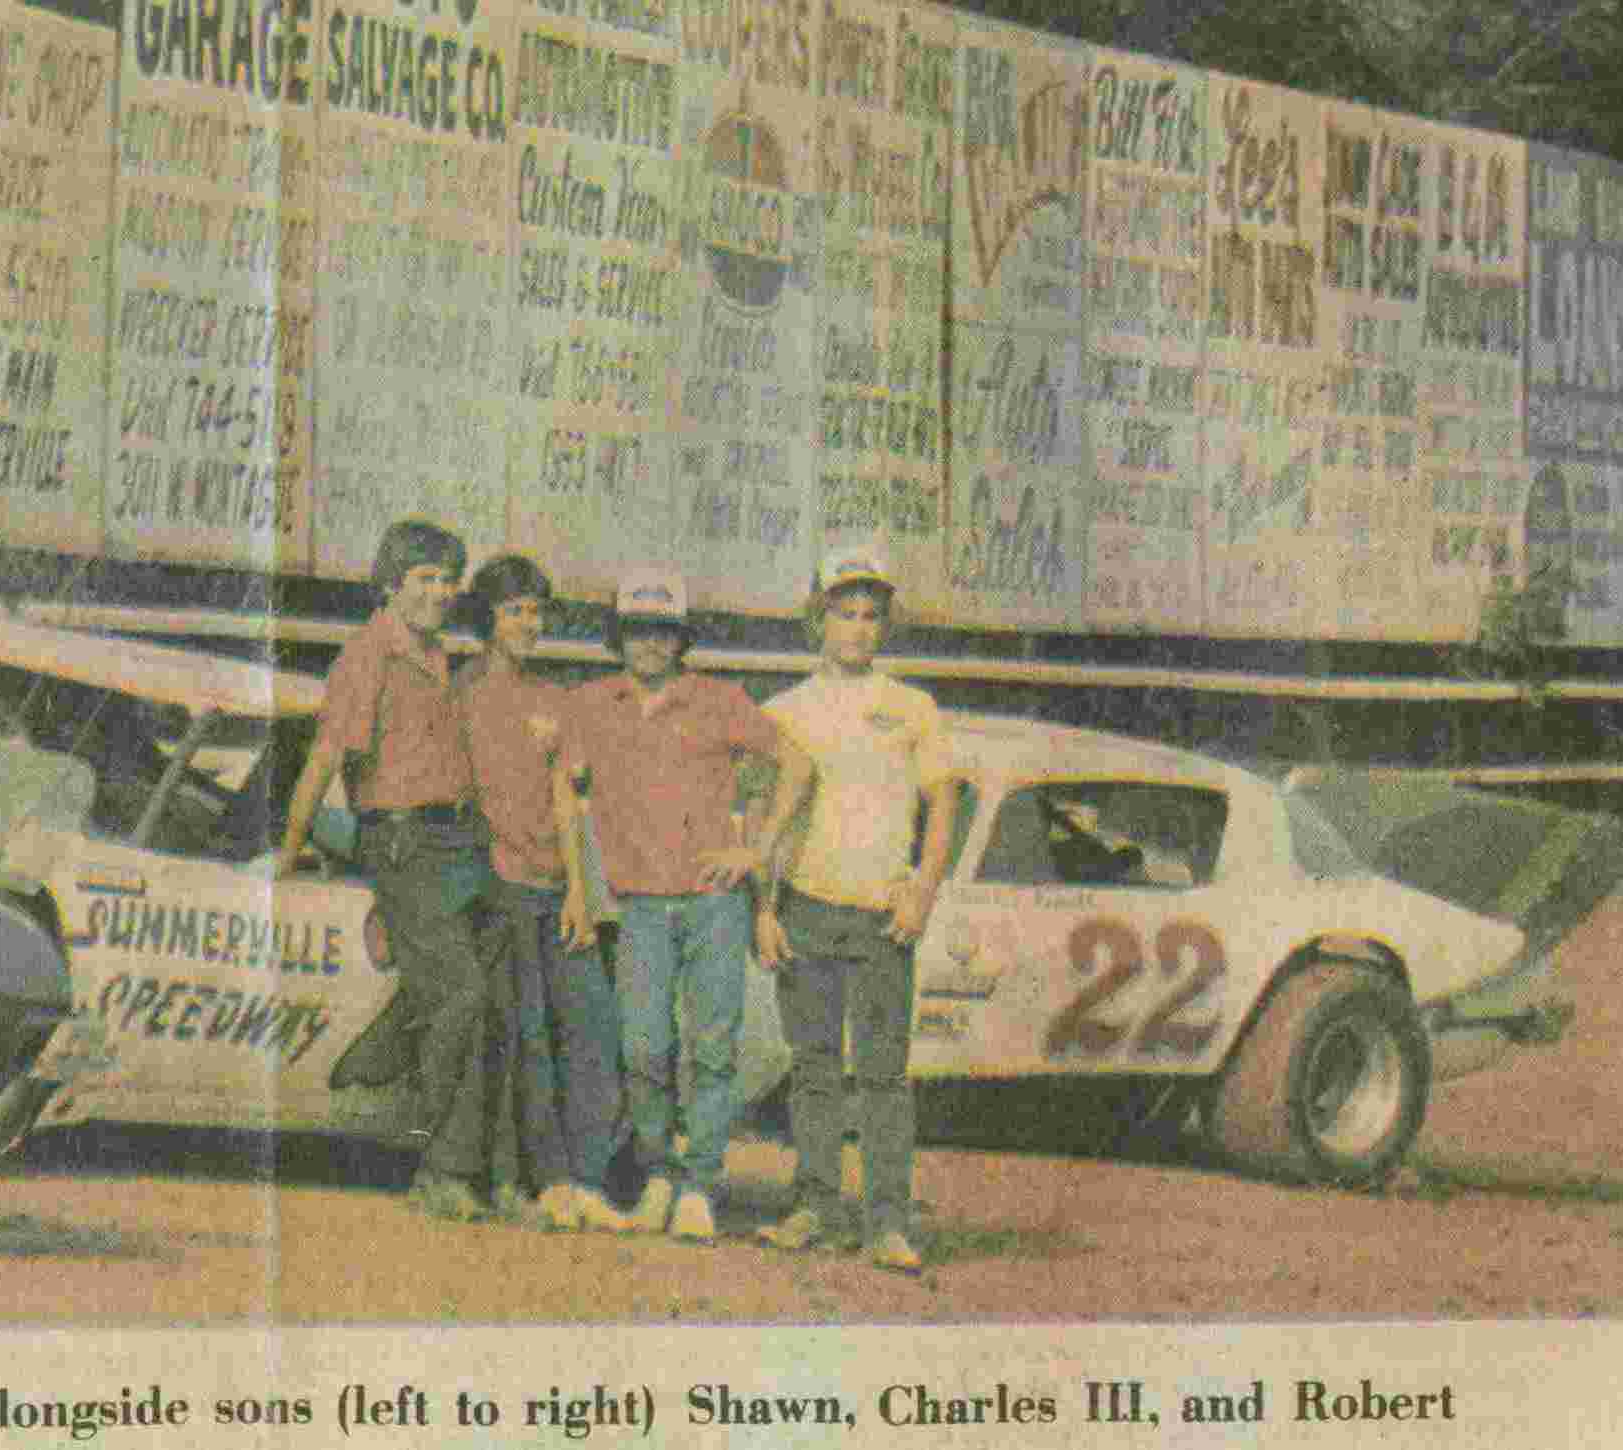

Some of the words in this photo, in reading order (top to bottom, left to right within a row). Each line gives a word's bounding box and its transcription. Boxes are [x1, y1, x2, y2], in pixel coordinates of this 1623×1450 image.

[29, 42, 103, 136] SHOP
[131, 0, 308, 104] GARAGE
[325, 9, 457, 132] SALVAGE
[516, 143, 607, 237] Custom
[74, 897, 345, 976] SUMMERVILLE
[1042, 910, 1227, 1057] 22
[95, 972, 327, 1064] SPEEDWAY
